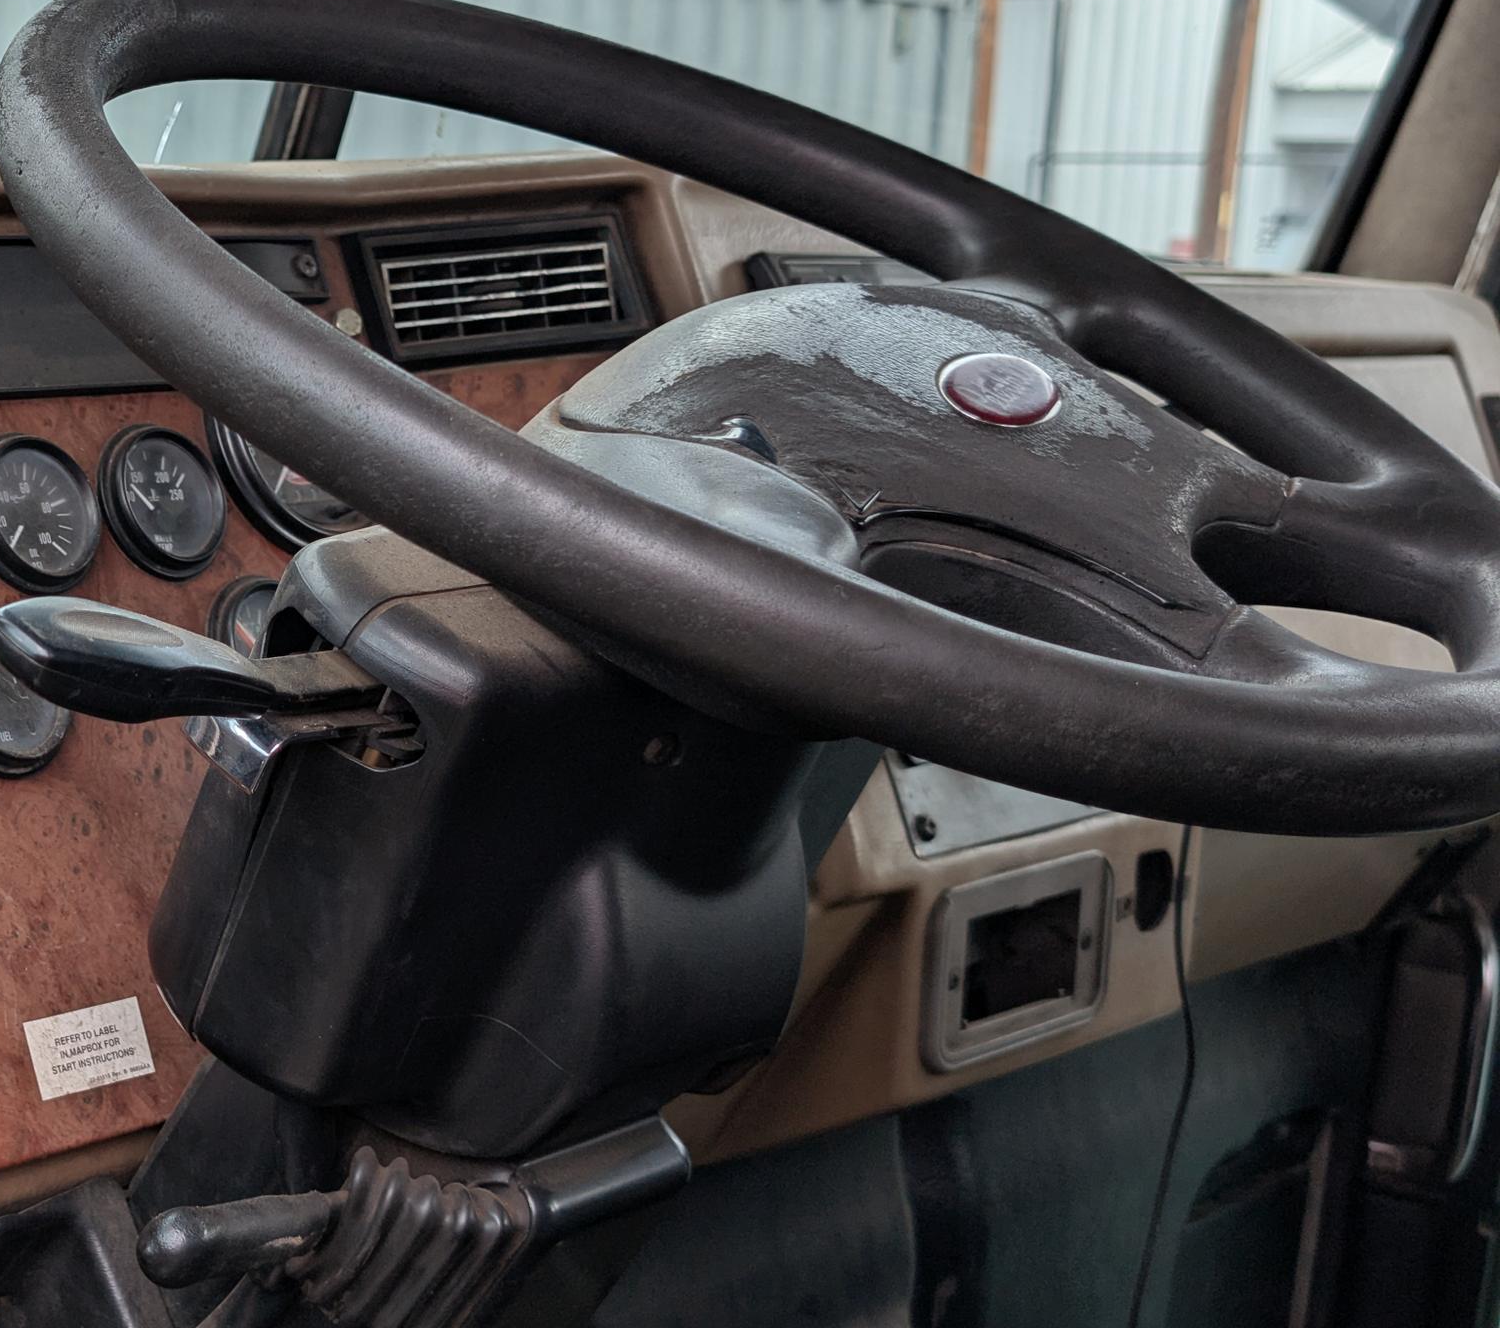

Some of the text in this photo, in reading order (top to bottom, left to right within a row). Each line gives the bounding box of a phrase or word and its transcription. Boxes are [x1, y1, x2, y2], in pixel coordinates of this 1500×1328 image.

[39, 532, 52, 544] 100
[54, 1024, 119, 1047] REFER TO LABEL
[104, 1037, 121, 1049] FOR
[51, 1062, 77, 1075] START
